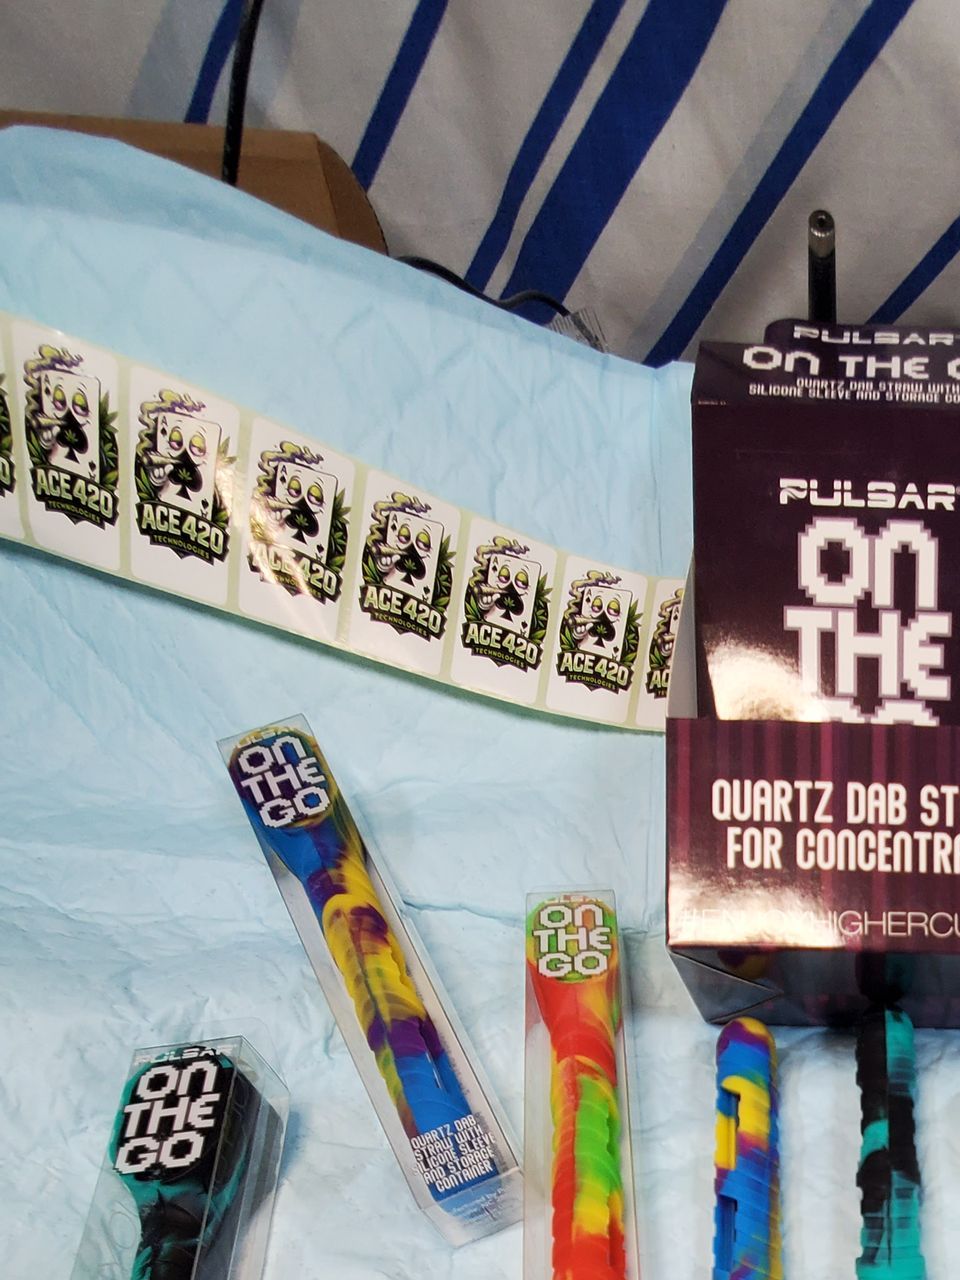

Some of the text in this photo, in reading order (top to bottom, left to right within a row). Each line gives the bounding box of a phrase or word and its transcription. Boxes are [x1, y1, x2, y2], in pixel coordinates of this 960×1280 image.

[793, 325, 957, 346] PULSAR
[742, 346, 820, 376] ON
[838, 355, 930, 379] THE
[749, 384, 803, 398] SILICONE
[808, 386, 851, 400] SLEEVE
[856, 388, 880, 401] AND
[886, 389, 940, 403] STORAGE
[796, 378, 960, 394] QUARTZ DAB STRAW WITH
[36, 468, 73, 500] ACE
[72, 479, 113, 519] 420
[779, 478, 957, 511] PULSAR
[141, 503, 225, 555] ACE 420
[153, 534, 211, 560] TECHNOLOGIES
[301, 557, 337, 597] 420
[798, 517, 939, 610] ON
[364, 585, 442, 634] ACE 420
[374, 612, 428, 637] TECHNOLOGIES
[465, 623, 538, 665] ACE 420
[475, 647, 526, 669] TECHNOLOGIES
[784, 605, 952, 700] THE
[560, 652, 629, 687] ACE 420
[238, 735, 307, 775] ON
[240, 757, 326, 804] THE
[259, 786, 331, 828] GO
[712, 779, 834, 823] QUARTZ
[846, 782, 908, 826] DAB
[727, 826, 783, 870] FOR
[540, 904, 603, 928] ON
[532, 927, 612, 953] THE
[538, 951, 607, 978] GO
[136, 1060, 219, 1100] ON
[123, 1093, 221, 1138] THE
[411, 1114, 477, 1149] QUARTZ DAB
[114, 1130, 205, 1174] GO
[413, 1132, 496, 1175] SILICONE SLEEVE
[415, 1124, 483, 1160] STRAW WITH
[423, 1146, 495, 1185] AND STORAGE
[435, 1160, 493, 1193] CONTAINER
